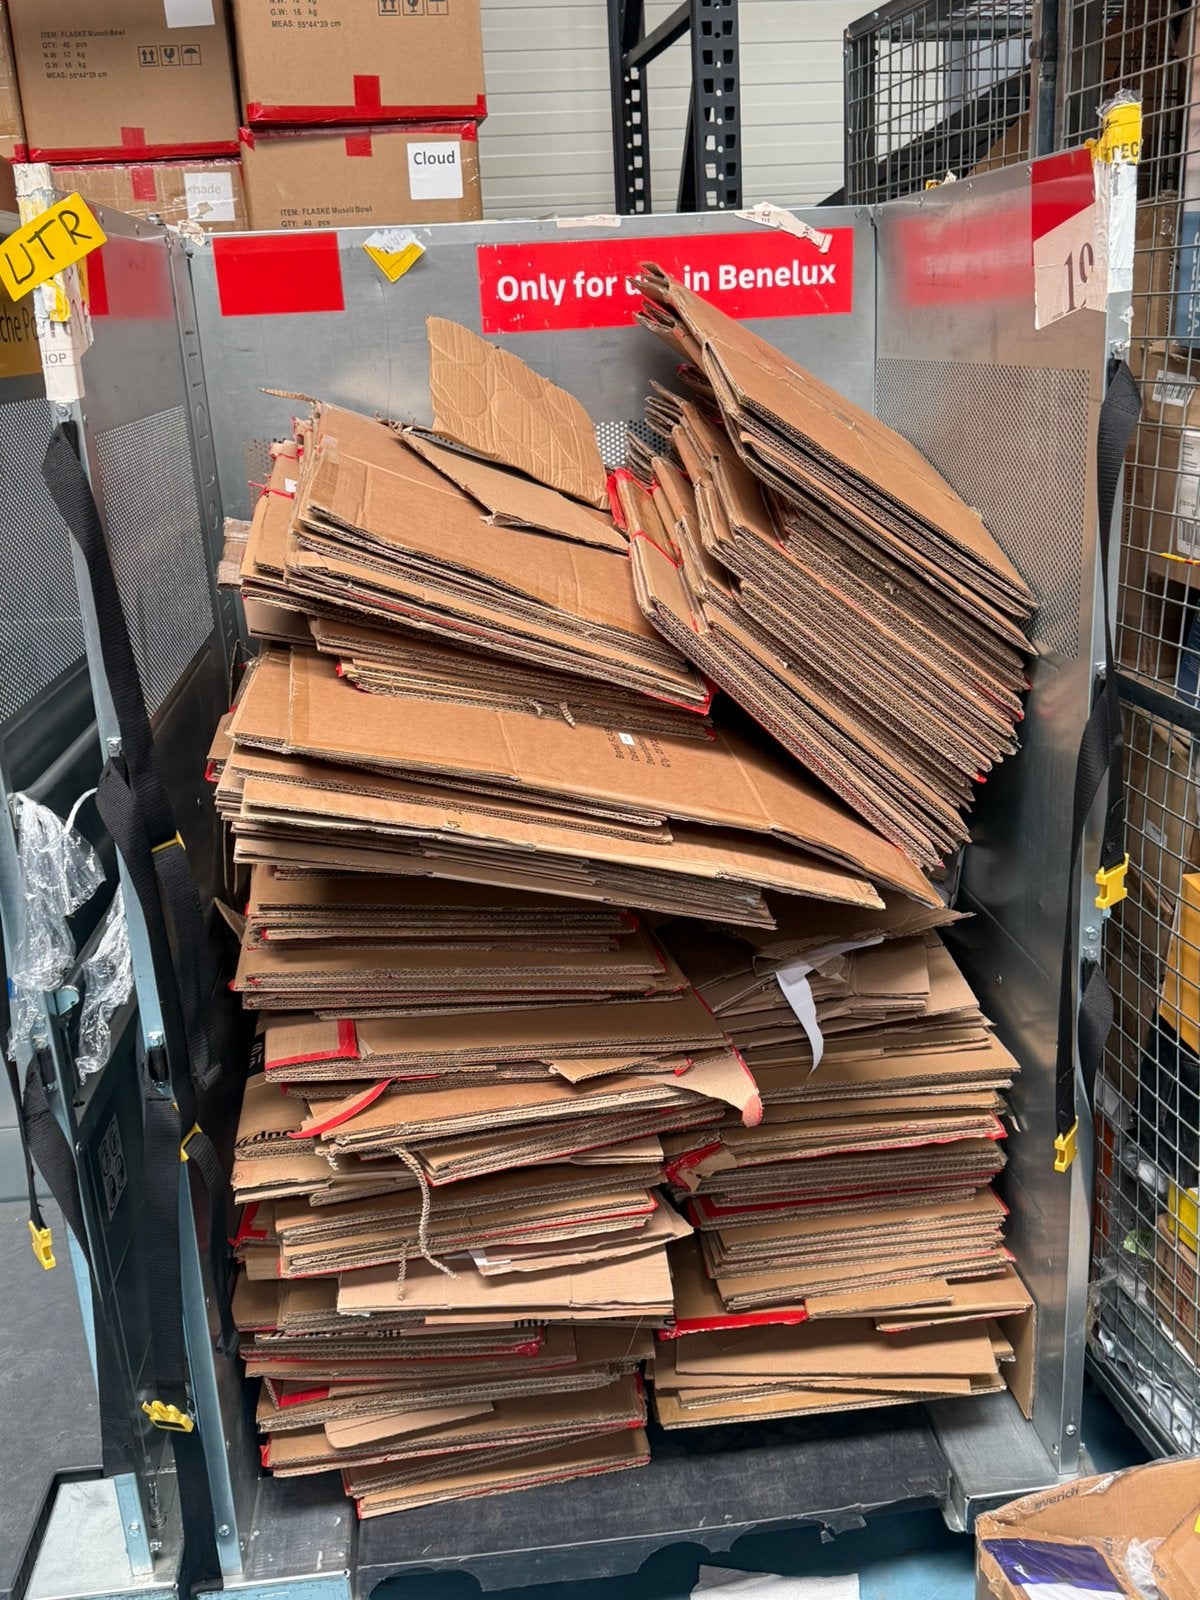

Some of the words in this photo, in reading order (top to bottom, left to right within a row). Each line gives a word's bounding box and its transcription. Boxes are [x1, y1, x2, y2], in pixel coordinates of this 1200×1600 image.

[308, 7, 318, 17] kg
[271, 20, 296, 28] MEAS:
[330, 20, 342, 28] cm
[77, 51, 86, 60] kg
[78, 61, 87, 69] kg
[413, 150, 456, 165] Cloud
[280, 208, 300, 217] ITEM:
[302, 207, 331, 216] FLASKE
[281, 220, 299, 229] QTY:
[317, 220, 331, 228] pcs
[5, 209, 93, 285] UTR
[497, 274, 565, 306] Only
[573, 271, 617, 298] for
[683, 264, 711, 292] in
[718, 260, 836, 289] Benelux
[1034, 1486, 1080, 1510] everich
